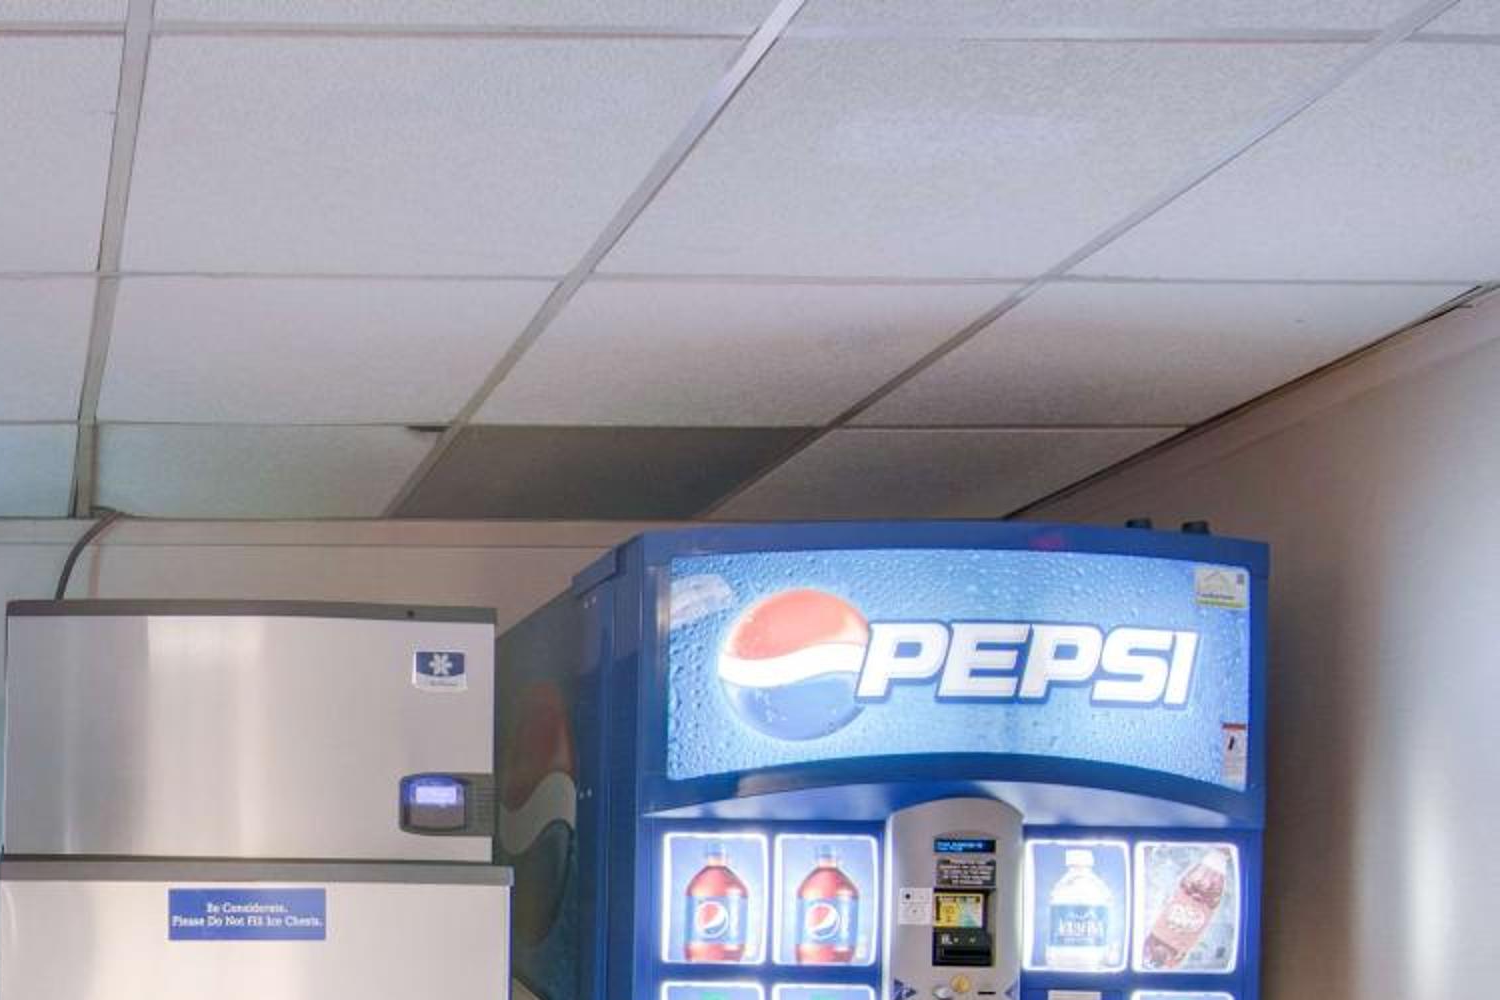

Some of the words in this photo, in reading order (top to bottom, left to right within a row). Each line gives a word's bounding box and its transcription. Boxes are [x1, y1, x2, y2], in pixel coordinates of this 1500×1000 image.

[854, 622, 1200, 706] PEPSI
[172, 916, 205, 927] Please
[207, 916, 223, 927] Do
[226, 916, 245, 927] Not
[267, 916, 282, 927] Ice
